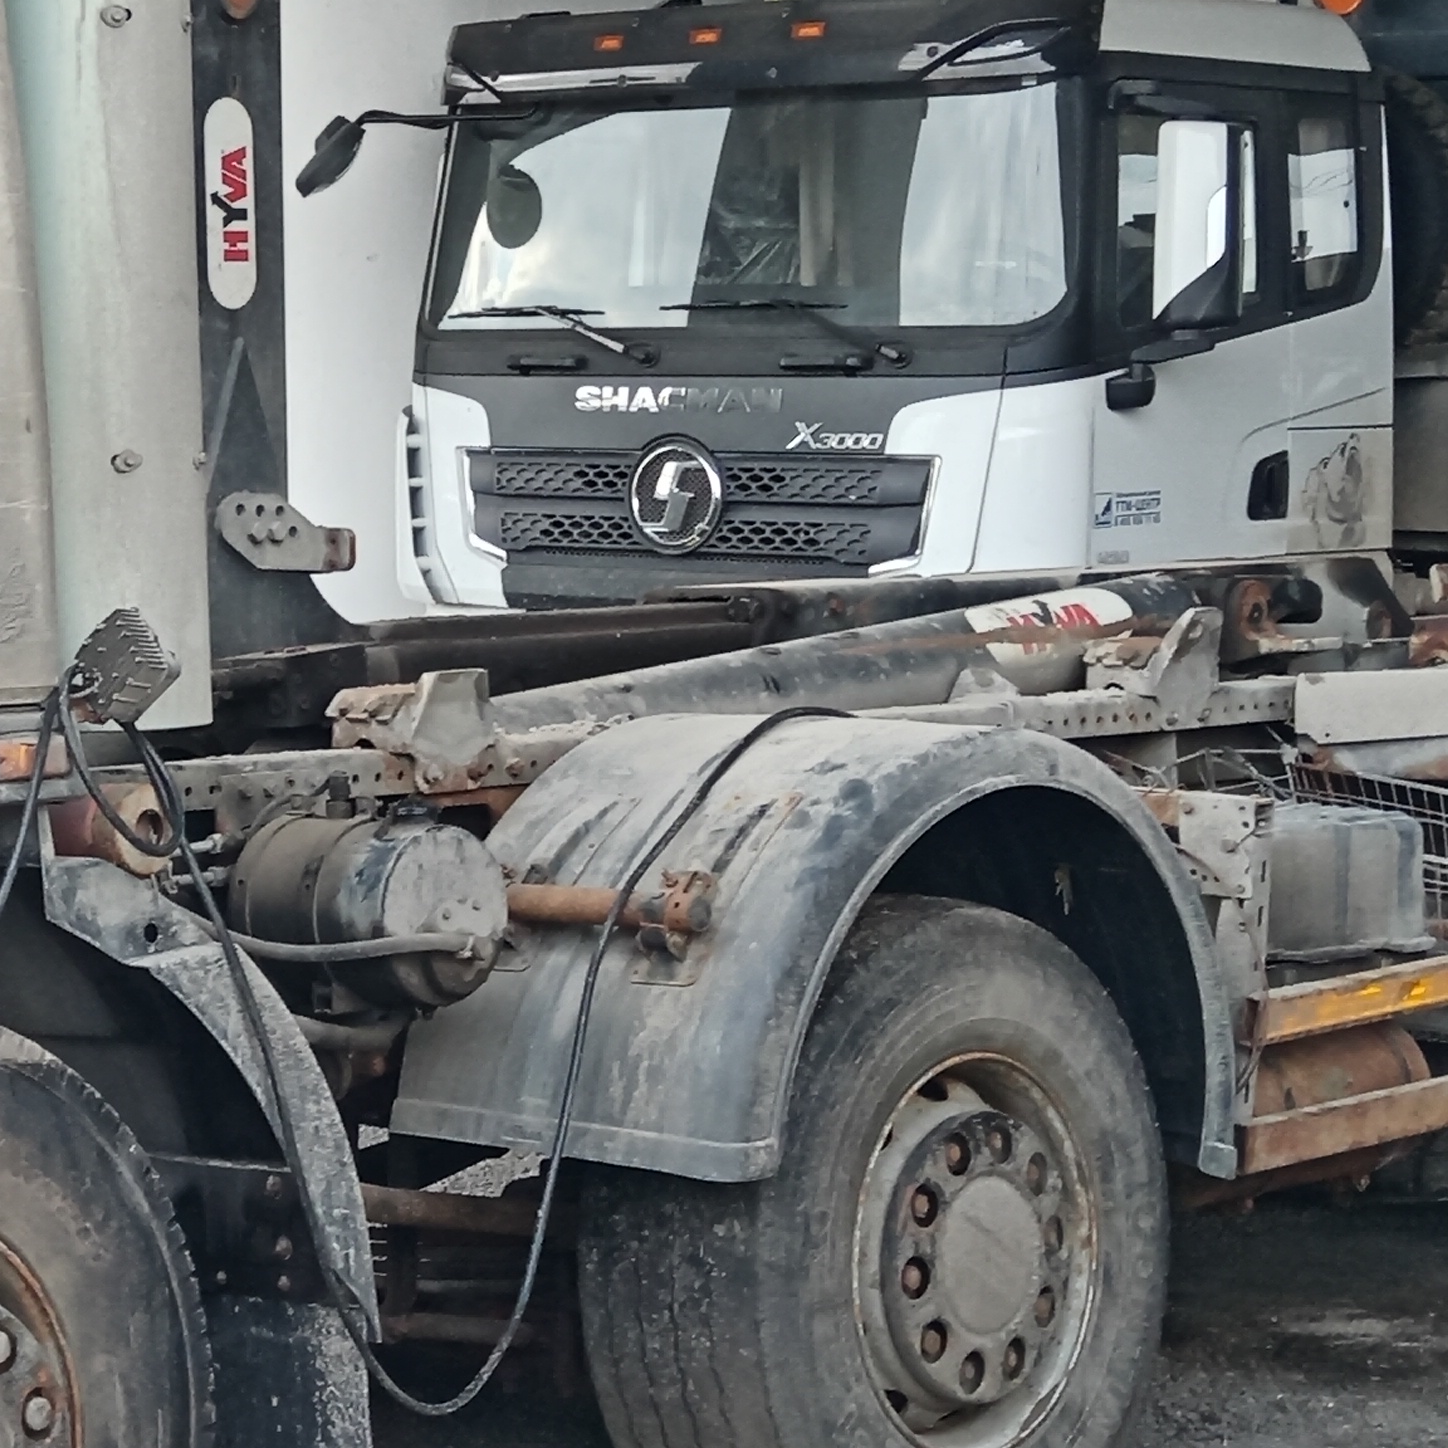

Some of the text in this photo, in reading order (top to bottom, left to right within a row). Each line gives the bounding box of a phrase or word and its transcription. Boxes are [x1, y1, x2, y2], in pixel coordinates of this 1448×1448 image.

[210, 146, 249, 262] HYVA
[574, 386, 783, 413] SHACMAN
[785, 421, 884, 450] X3000
